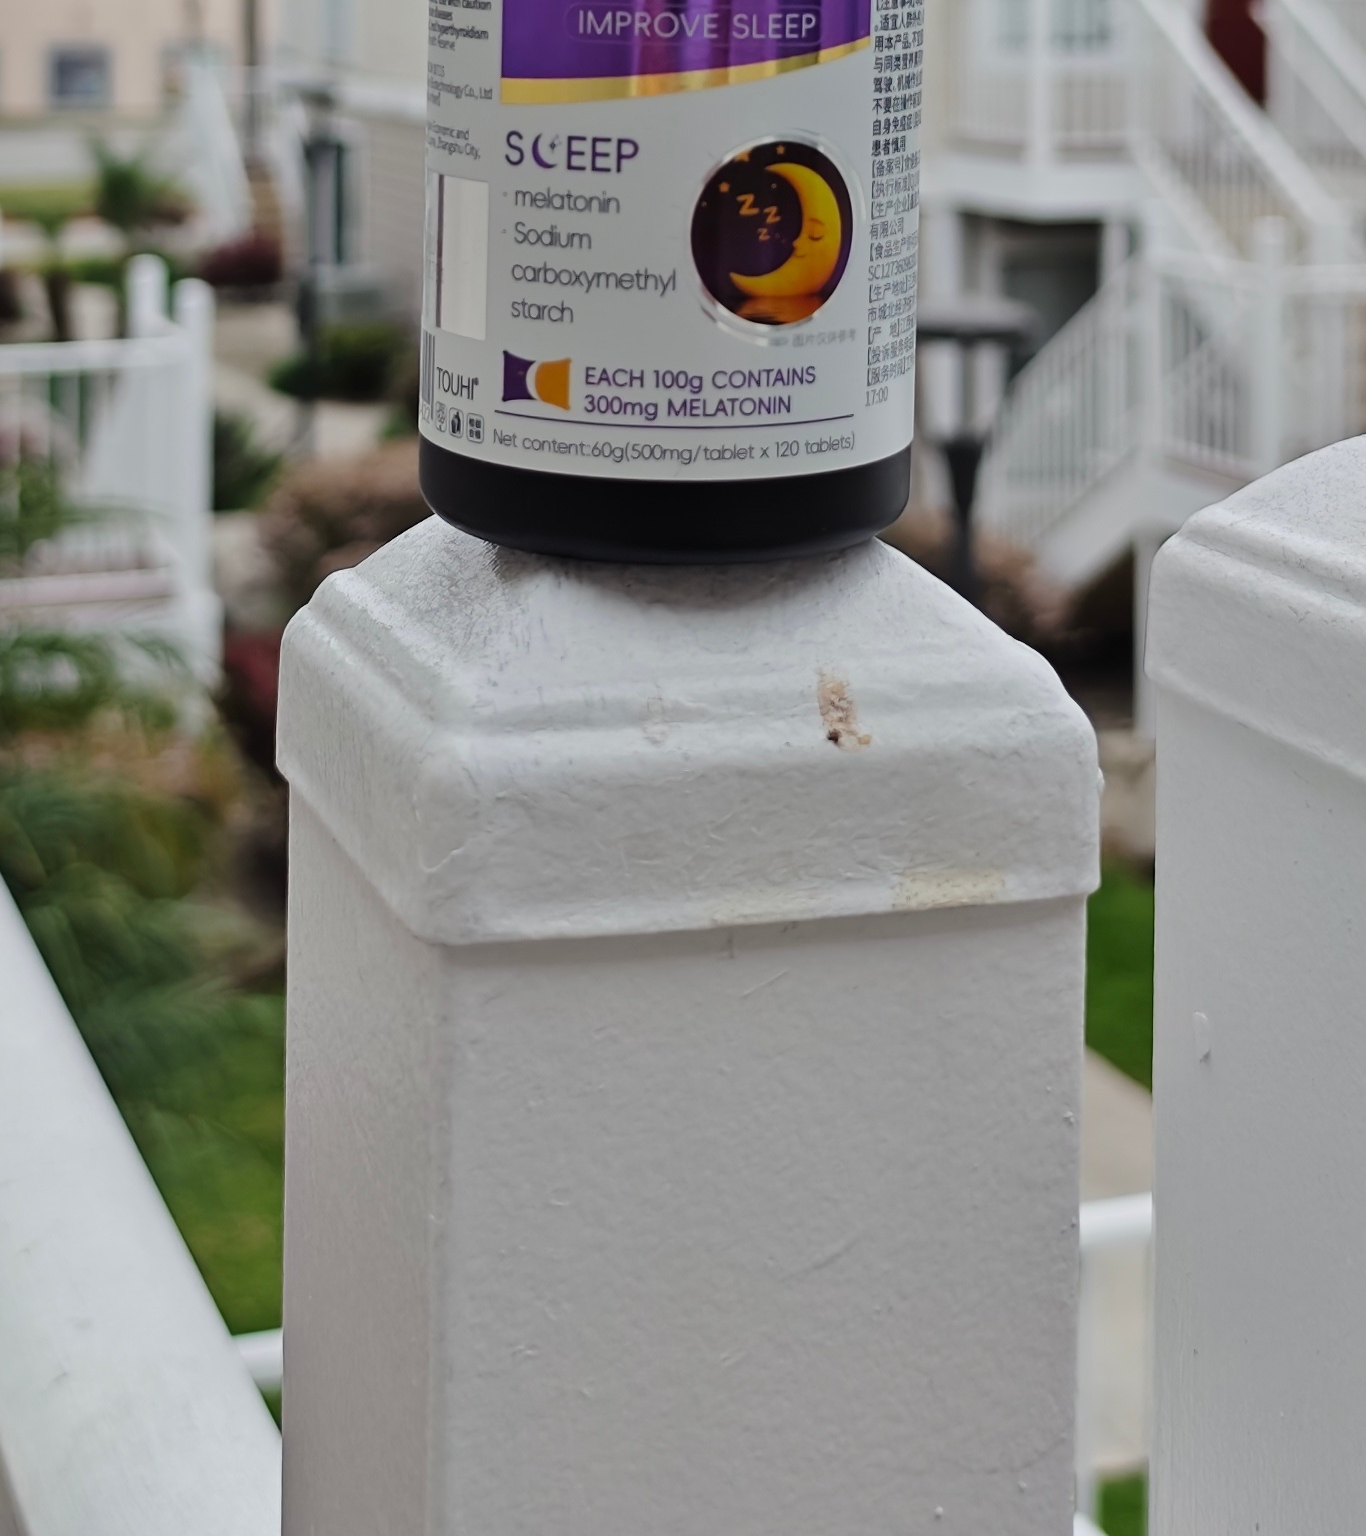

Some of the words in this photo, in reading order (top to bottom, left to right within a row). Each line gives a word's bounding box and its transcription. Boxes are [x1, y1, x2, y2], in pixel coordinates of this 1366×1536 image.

[578, 9, 718, 40] IMPROVE
[732, 13, 817, 40] SLEEP
[514, 186, 621, 214] melatonin
[514, 221, 592, 250] Sodium
[869, 216, 905, 240] 有限公司
[511, 261, 677, 297] carboxymethyl
[511, 298, 574, 323] starch
[584, 366, 645, 388] EACH
[653, 369, 703, 394] 100g
[711, 365, 817, 389] CONTAINS
[584, 394, 659, 421] 300mg
[667, 395, 791, 417] MELATONIN
[865, 385, 889, 407] 17:00
[493, 428, 518, 448] Net
[759, 446, 770, 459] x
[775, 440, 800, 458] 120
[805, 431, 856, 455] tablets)
